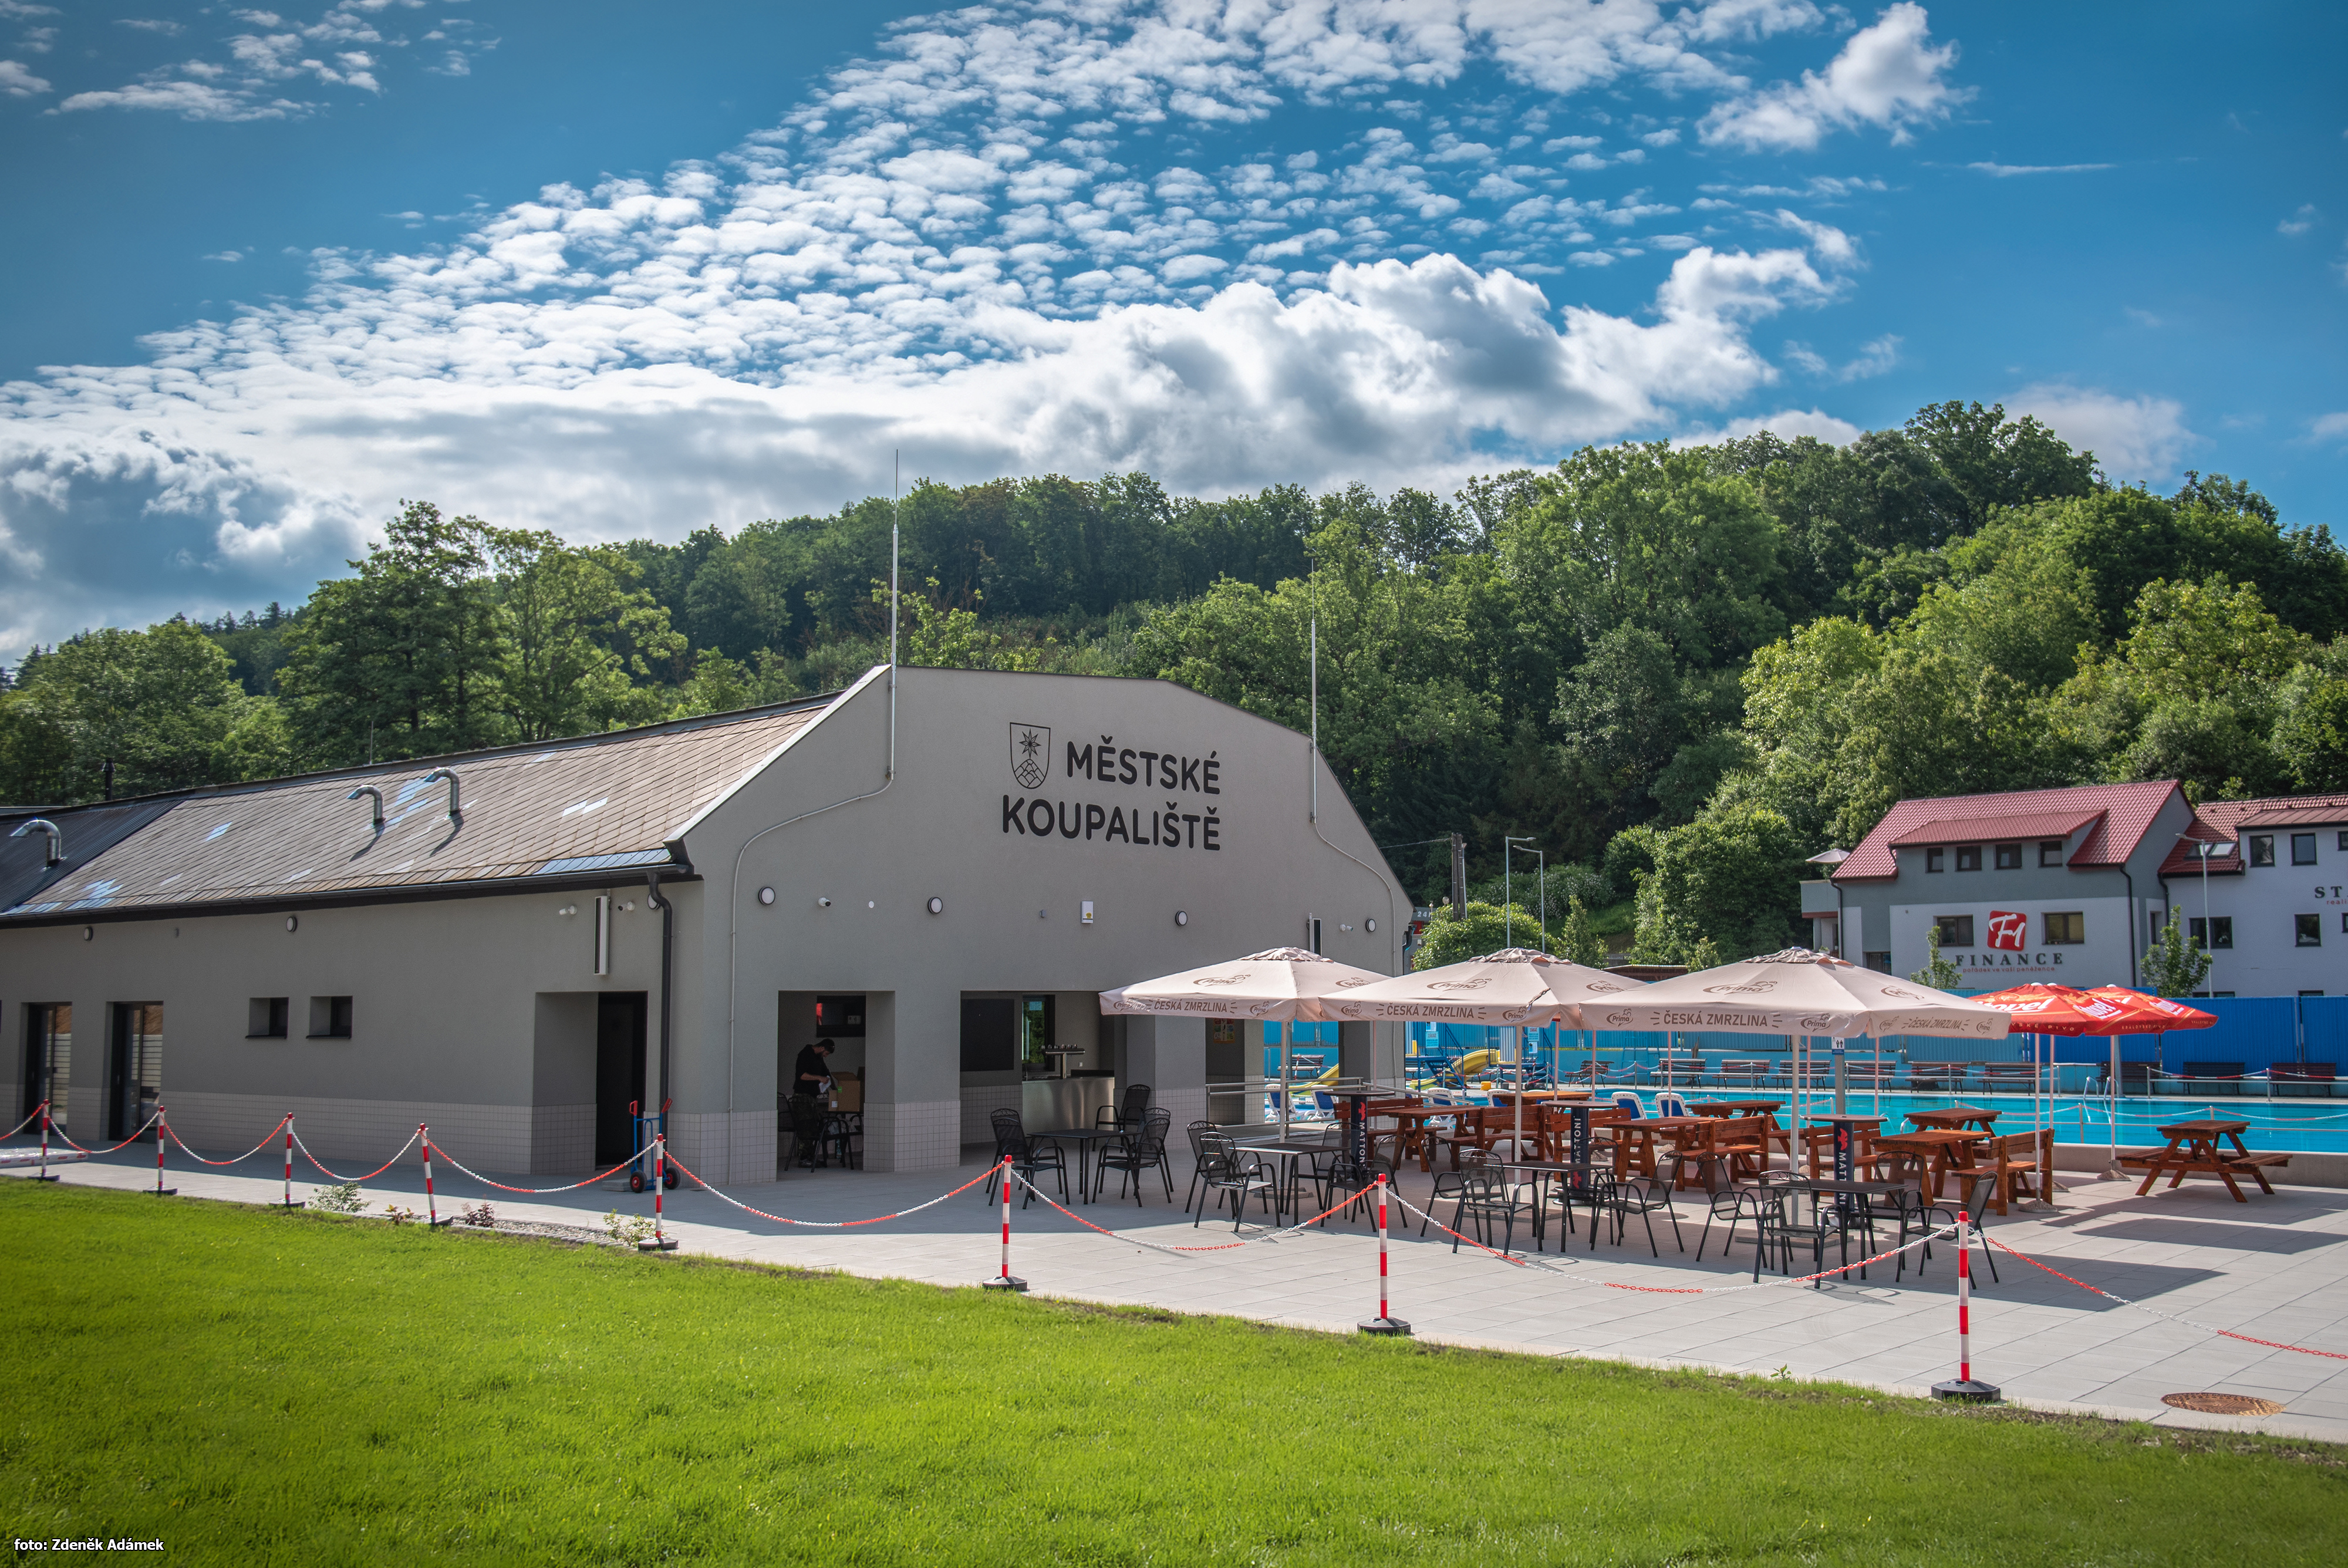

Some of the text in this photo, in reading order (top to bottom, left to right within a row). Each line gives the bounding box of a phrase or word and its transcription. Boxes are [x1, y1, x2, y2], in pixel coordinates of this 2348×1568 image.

[1067, 734, 1220, 795] MĚSTSKÉ
[1003, 794, 1220, 851] KOUPALIŠTĚ
[2314, 886, 2348, 898] ST
[1955, 953, 2063, 966] FINANCE
[1154, 999, 1227, 1013] ČESKÁ ZMRZLINA
[1387, 1003, 1475, 1018] ČESKÁ ZMRZLINA
[1664, 1010, 1767, 1027] ČESKÁ ZMRZLINA
[1908, 1017, 1962, 1030] ČESKÁ ZMRZLINA
[1838, 1152, 1847, 1204] MATTNI
